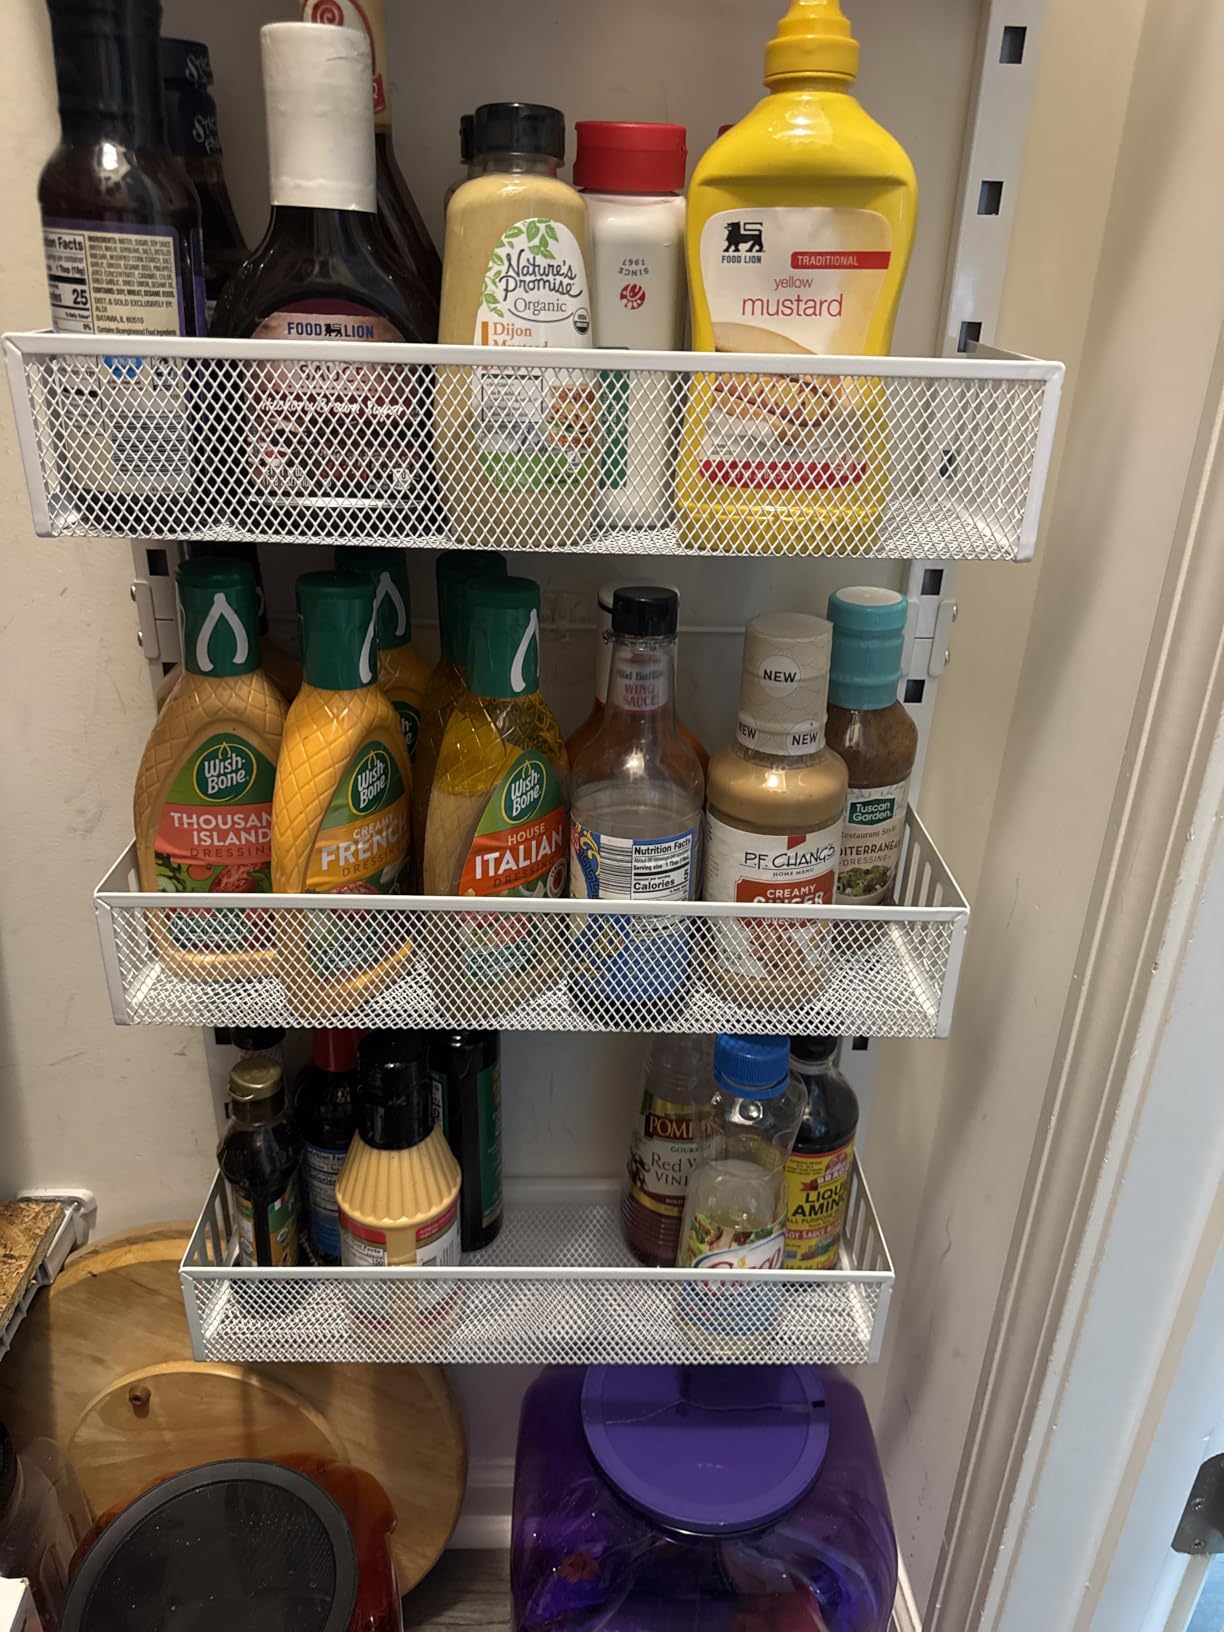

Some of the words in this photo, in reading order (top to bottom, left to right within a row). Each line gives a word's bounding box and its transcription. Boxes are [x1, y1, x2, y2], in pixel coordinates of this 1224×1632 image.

[506, 249, 576, 280] Nature's
[721, 255, 742, 264] FOOD
[744, 255, 761, 264] LION
[797, 255, 859, 266] TRADITIONAL
[499, 275, 583, 302] Promise
[774, 276, 814, 291] yellow
[72, 289, 88, 306] 25
[742, 294, 843, 317] mustard
[514, 298, 567, 316] Organic
[287, 321, 322, 337] FOOD
[344, 324, 374, 338] LION
[493, 322, 533, 340] Dijon
[763, 668, 797, 683] NEW
[792, 730, 818, 746] NEW
[208, 769, 246, 794] Bone
[360, 774, 386, 809] Bone
[512, 784, 540, 817] Bone
[852, 810, 890, 821] Garden
[855, 801, 890, 813] Tuscan
[170, 811, 272, 829] THOUSAN
[353, 813, 393, 839] CREAMY
[193, 828, 272, 846] ISLAND
[508, 823, 545, 846] HOUSE
[190, 846, 272, 857] DRESSIN
[475, 824, 562, 880] ITALIAN
[634, 845, 672, 856] Nutrition
[673, 837, 691, 850] Facts
[772, 842, 835, 869] CHANG'S
[633, 879, 675, 891] Calories
[766, 884, 817, 898] CREAMY
[651, 1151, 682, 1173] Red
[805, 1181, 847, 1204] LIQU
